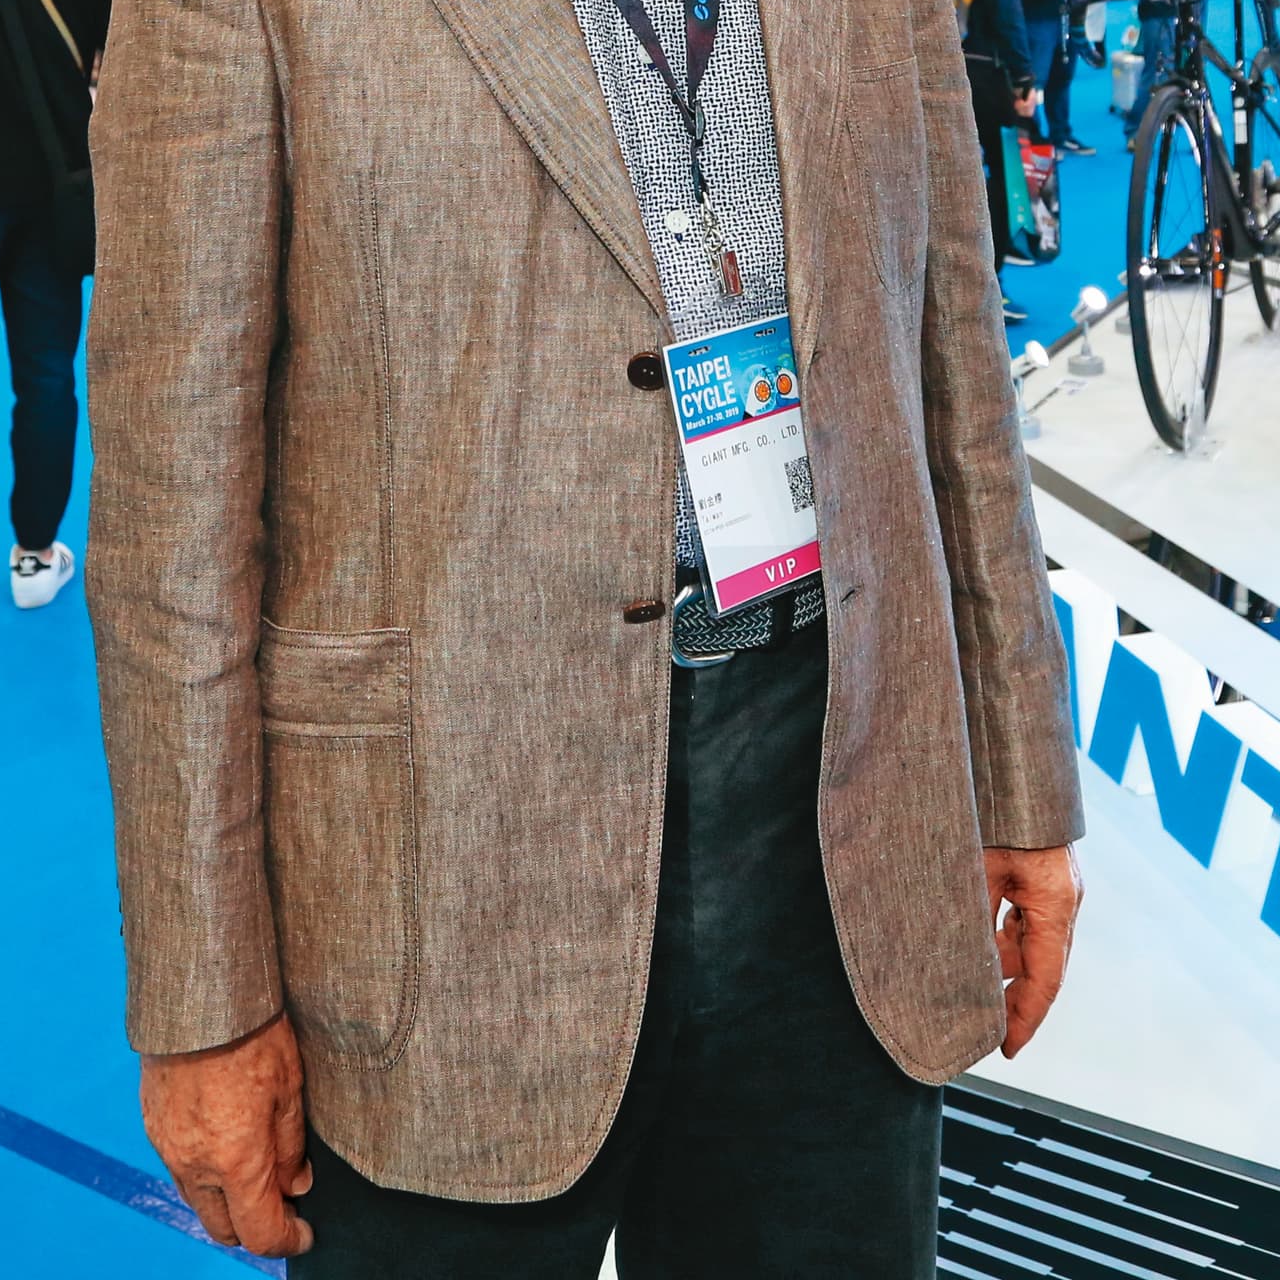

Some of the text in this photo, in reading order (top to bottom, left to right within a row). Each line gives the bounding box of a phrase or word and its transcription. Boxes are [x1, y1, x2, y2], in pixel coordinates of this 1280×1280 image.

[674, 355, 732, 392] TAIPEI
[681, 381, 736, 417] CYCLE
[686, 418, 706, 431] March
[725, 406, 739, 418] 2019
[701, 424, 801, 467] GIANT MFG. CO., LTD.
[765, 557, 797, 583] VIP
